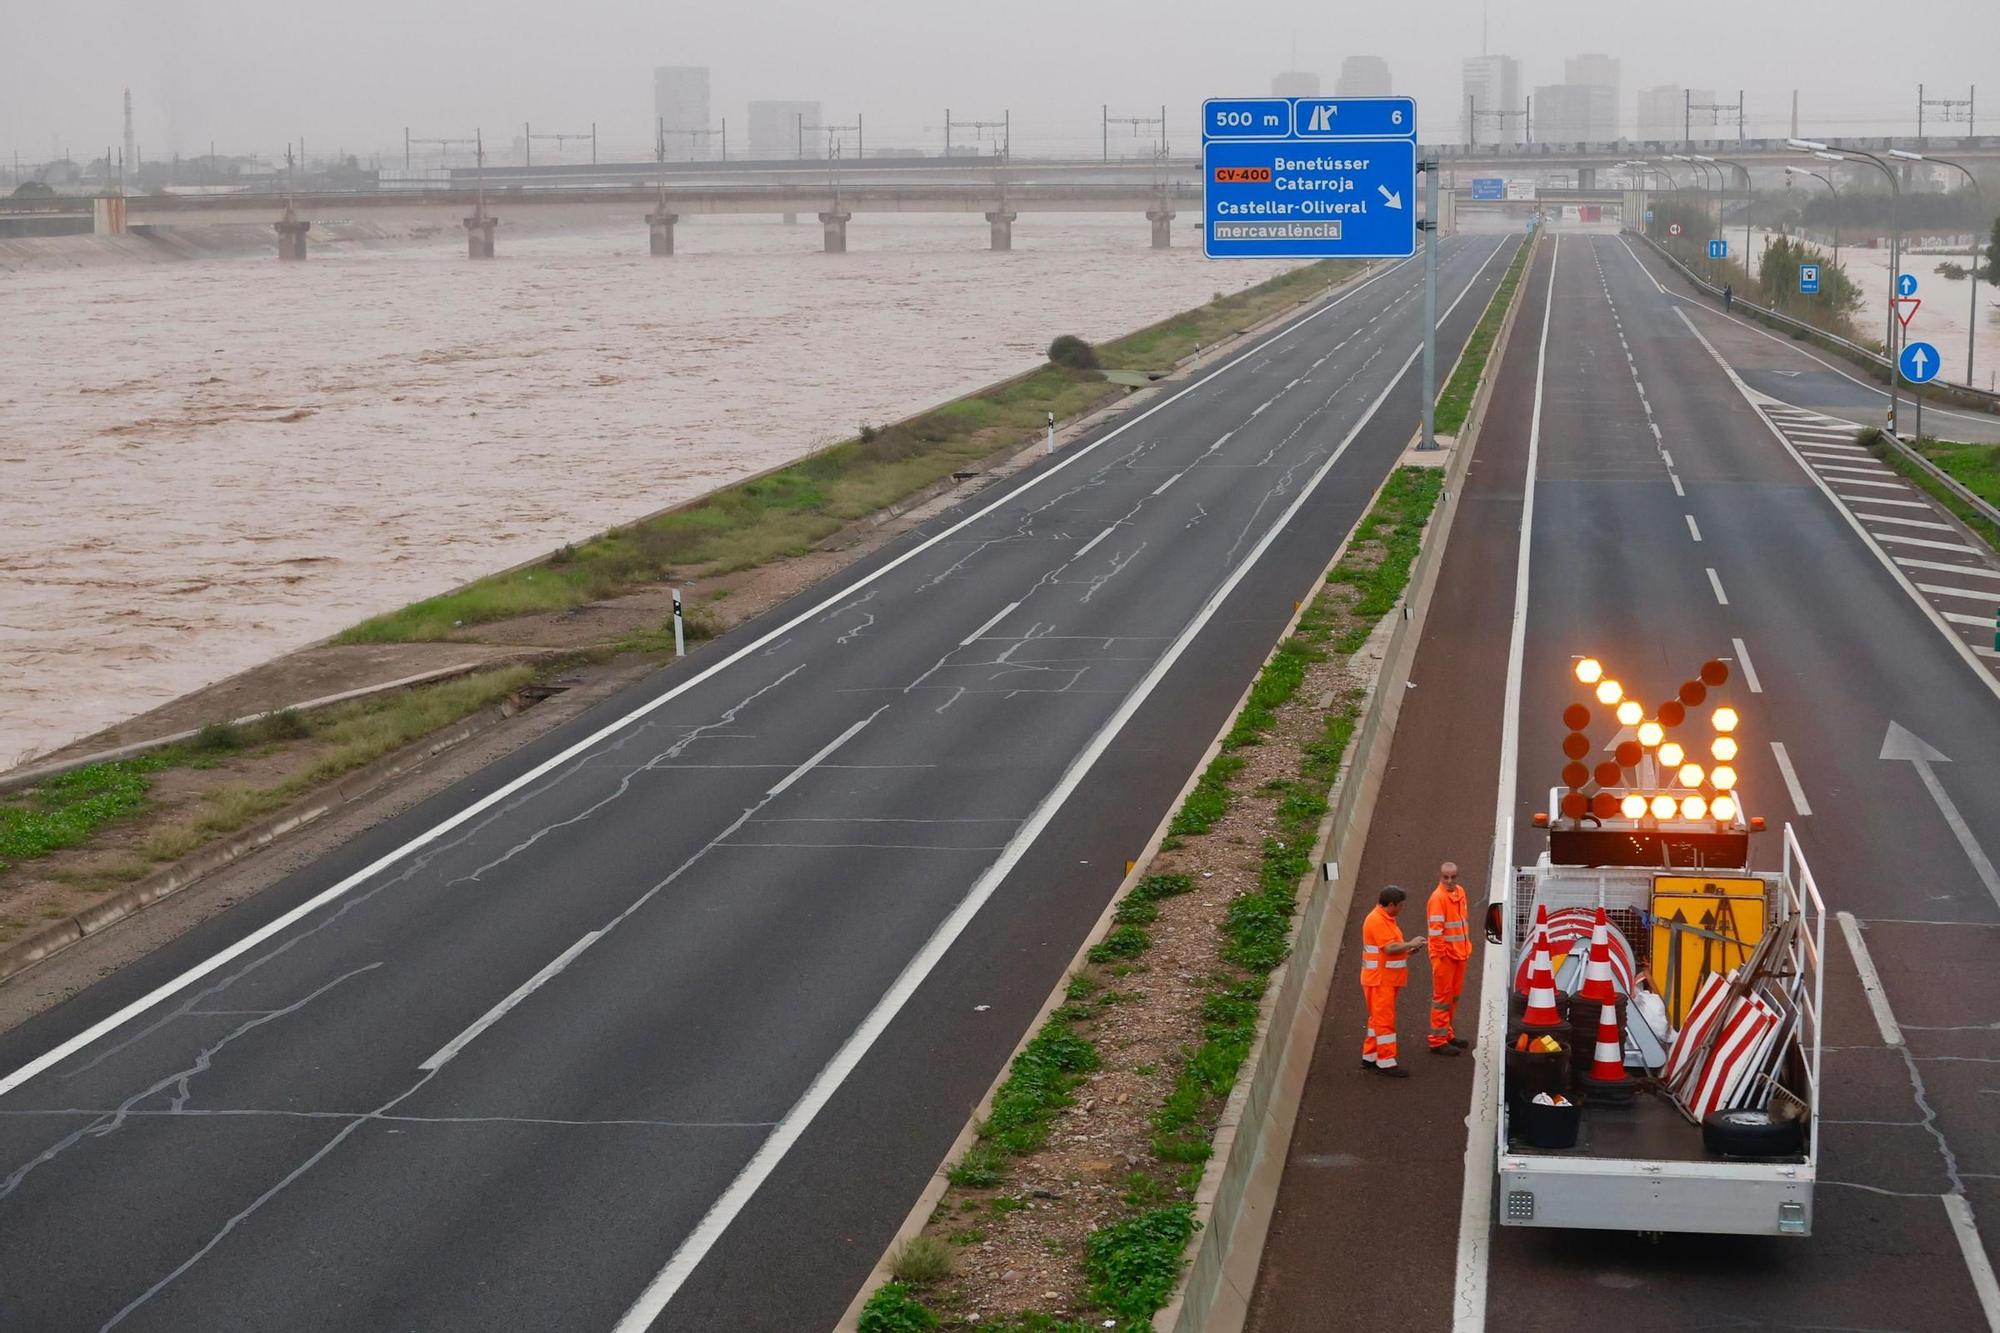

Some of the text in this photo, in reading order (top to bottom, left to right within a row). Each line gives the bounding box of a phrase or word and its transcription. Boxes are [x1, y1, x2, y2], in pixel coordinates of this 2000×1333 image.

[1216, 112, 1279, 126] 500 m
[1391, 110, 1403, 125] 6
[1274, 157, 1370, 171] Benetússer
[1216, 169, 1269, 181] CV-400
[1274, 177, 1354, 192] Catarroja
[1216, 200, 1367, 214] Castellar-Oliveral
[1216, 224, 1338, 237] mercavalència
